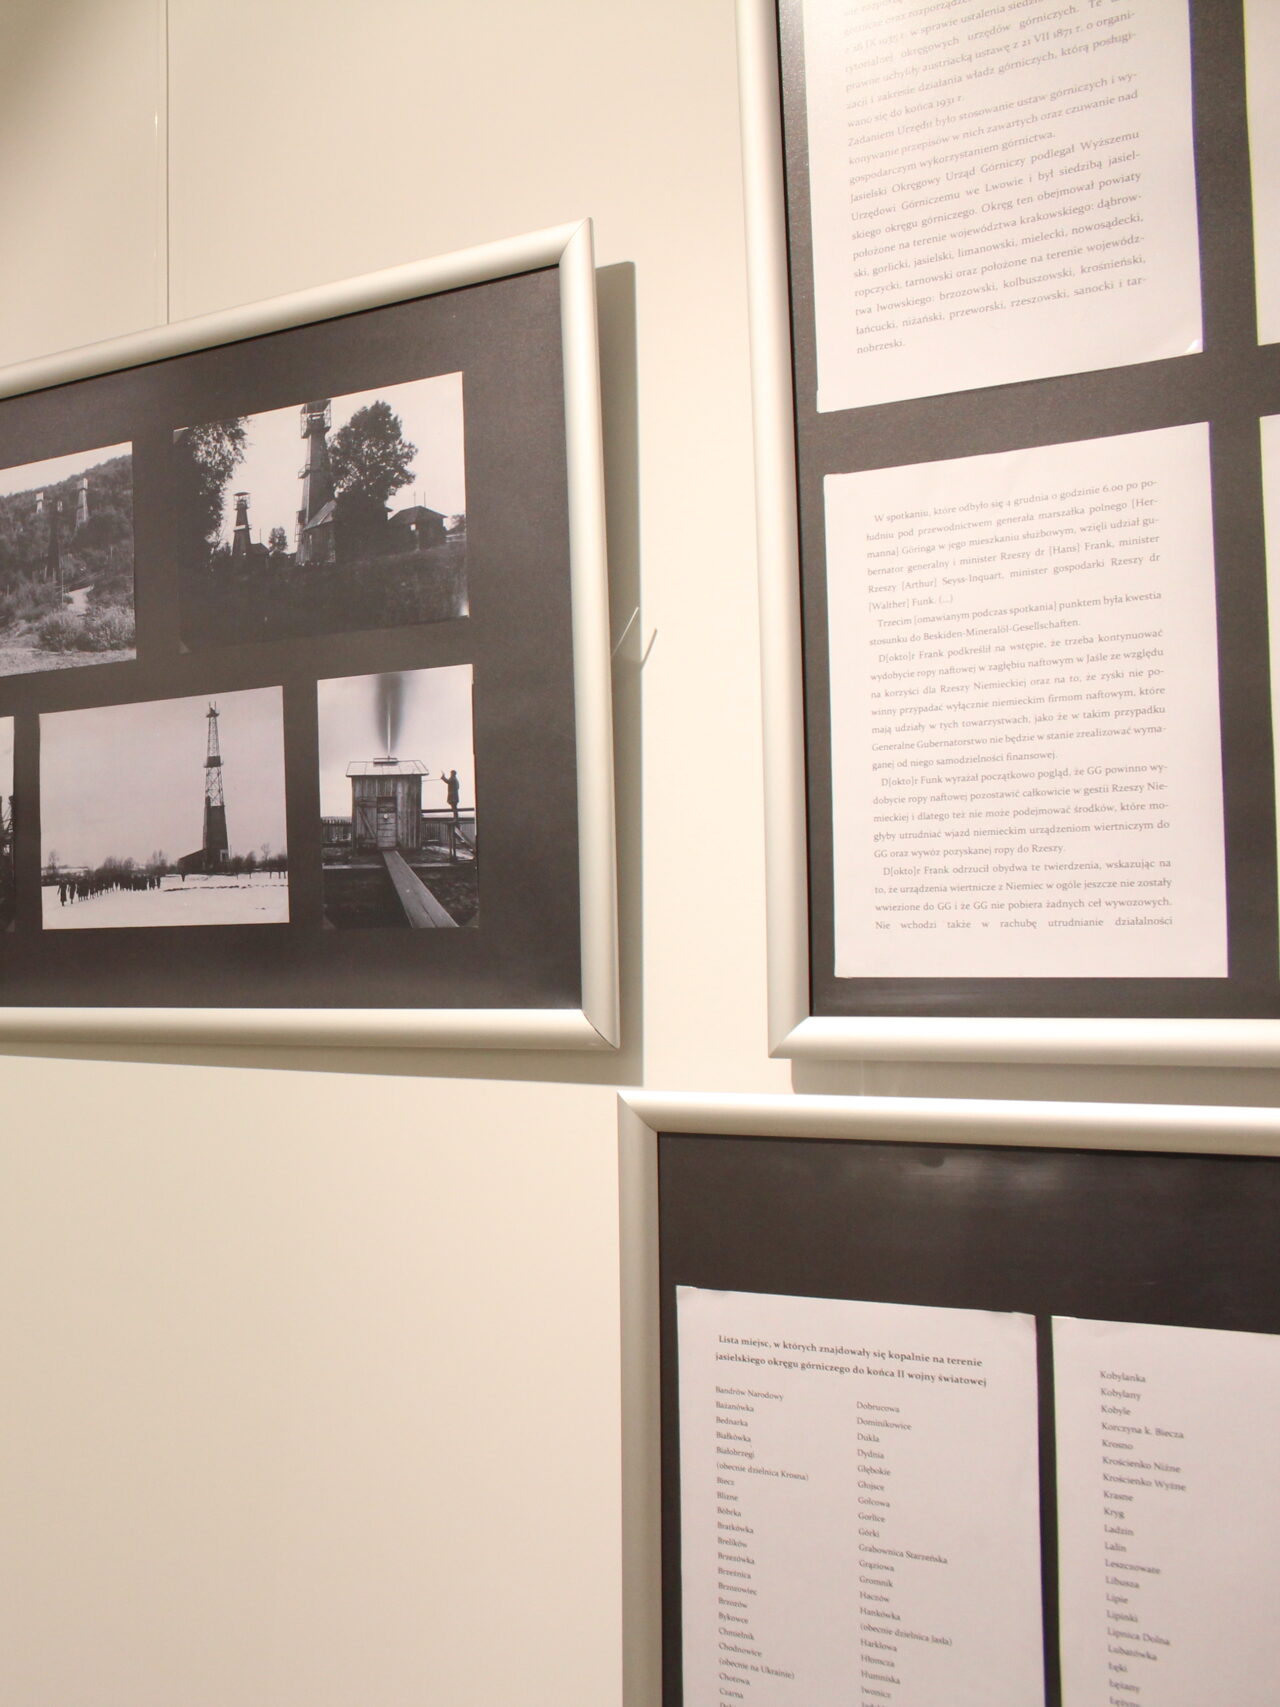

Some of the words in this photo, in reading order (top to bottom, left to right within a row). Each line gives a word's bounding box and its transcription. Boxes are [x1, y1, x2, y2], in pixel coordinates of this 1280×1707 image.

[718, 1334, 739, 1344] Lista
[887, 1349, 930, 1362] kopalnie
[932, 1356, 944, 1364] na
[946, 1357, 983, 1367] terenie
[715, 1351, 766, 1366] jasielskiego
[852, 1365, 864, 1374] do
[897, 1369, 904, 1378] II
[906, 1372, 935, 1383] wojny
